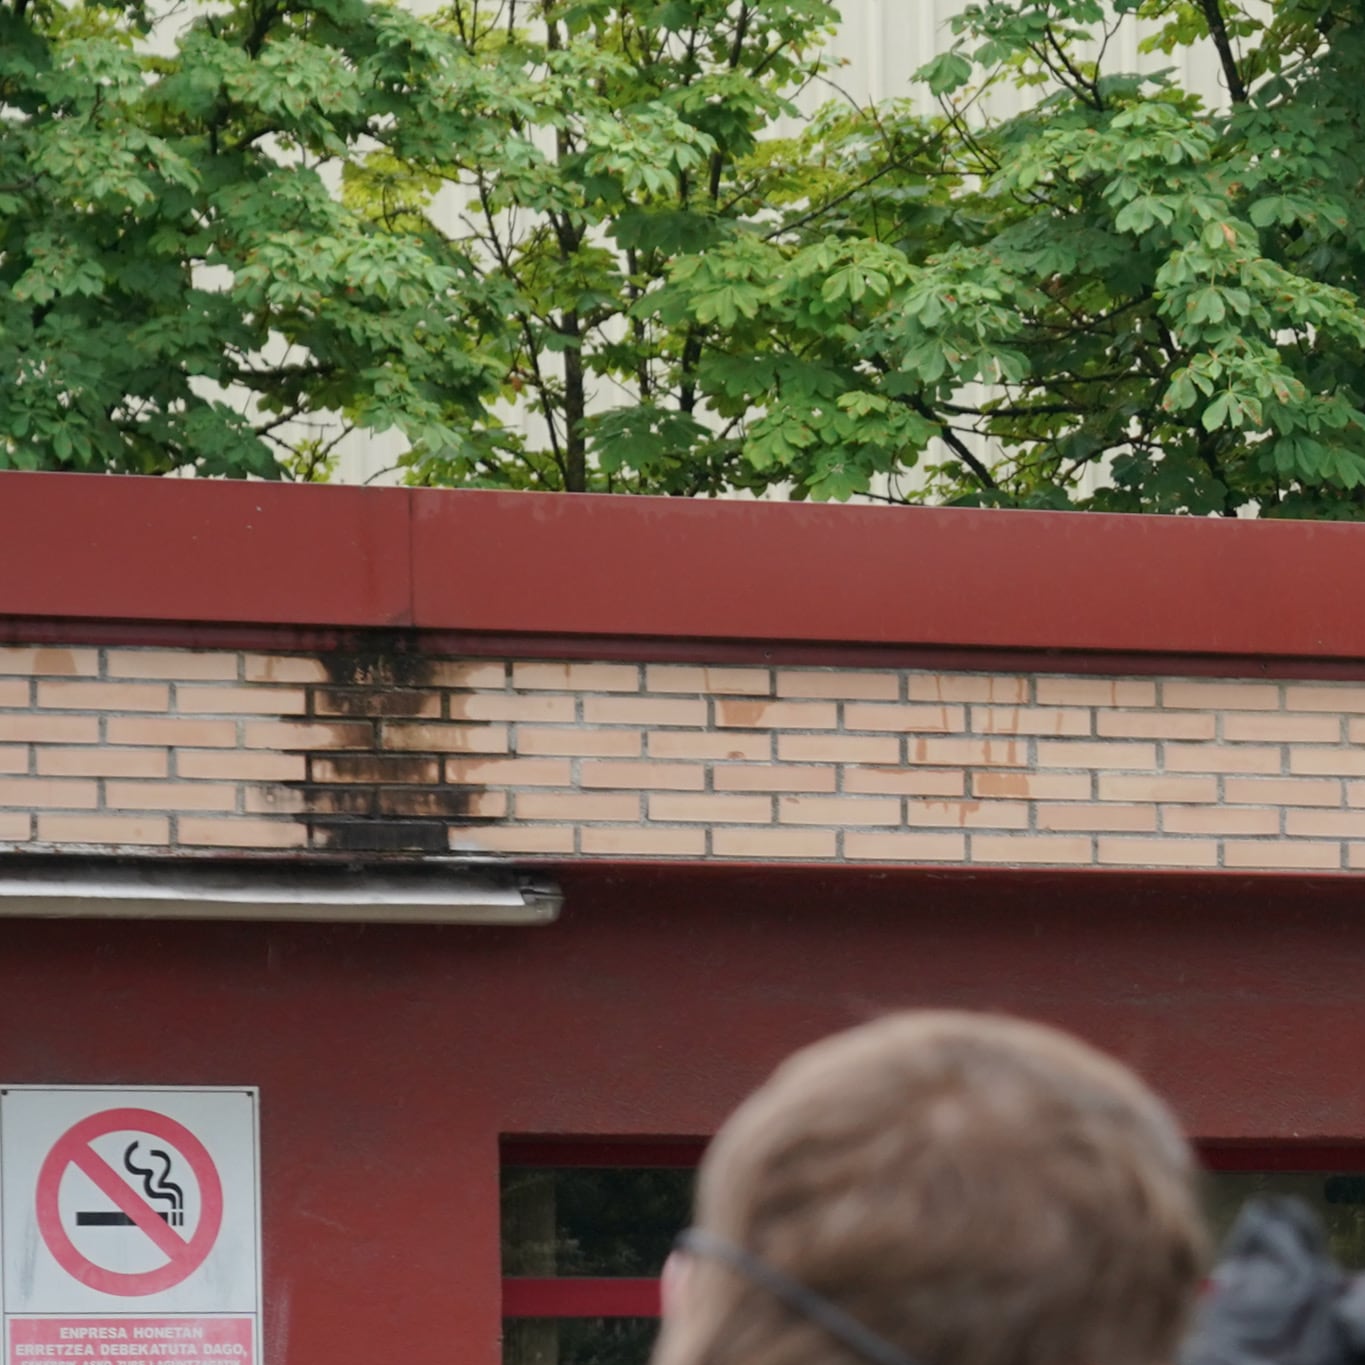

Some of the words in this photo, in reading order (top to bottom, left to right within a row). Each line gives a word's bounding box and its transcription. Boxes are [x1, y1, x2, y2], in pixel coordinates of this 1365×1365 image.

[60, 1327, 128, 1340] ENPRESA
[133, 1326, 203, 1339] HONETAN
[15, 1344, 95, 1356] ERRETZEA
[100, 1343, 198, 1356] DEBEKATUTA
